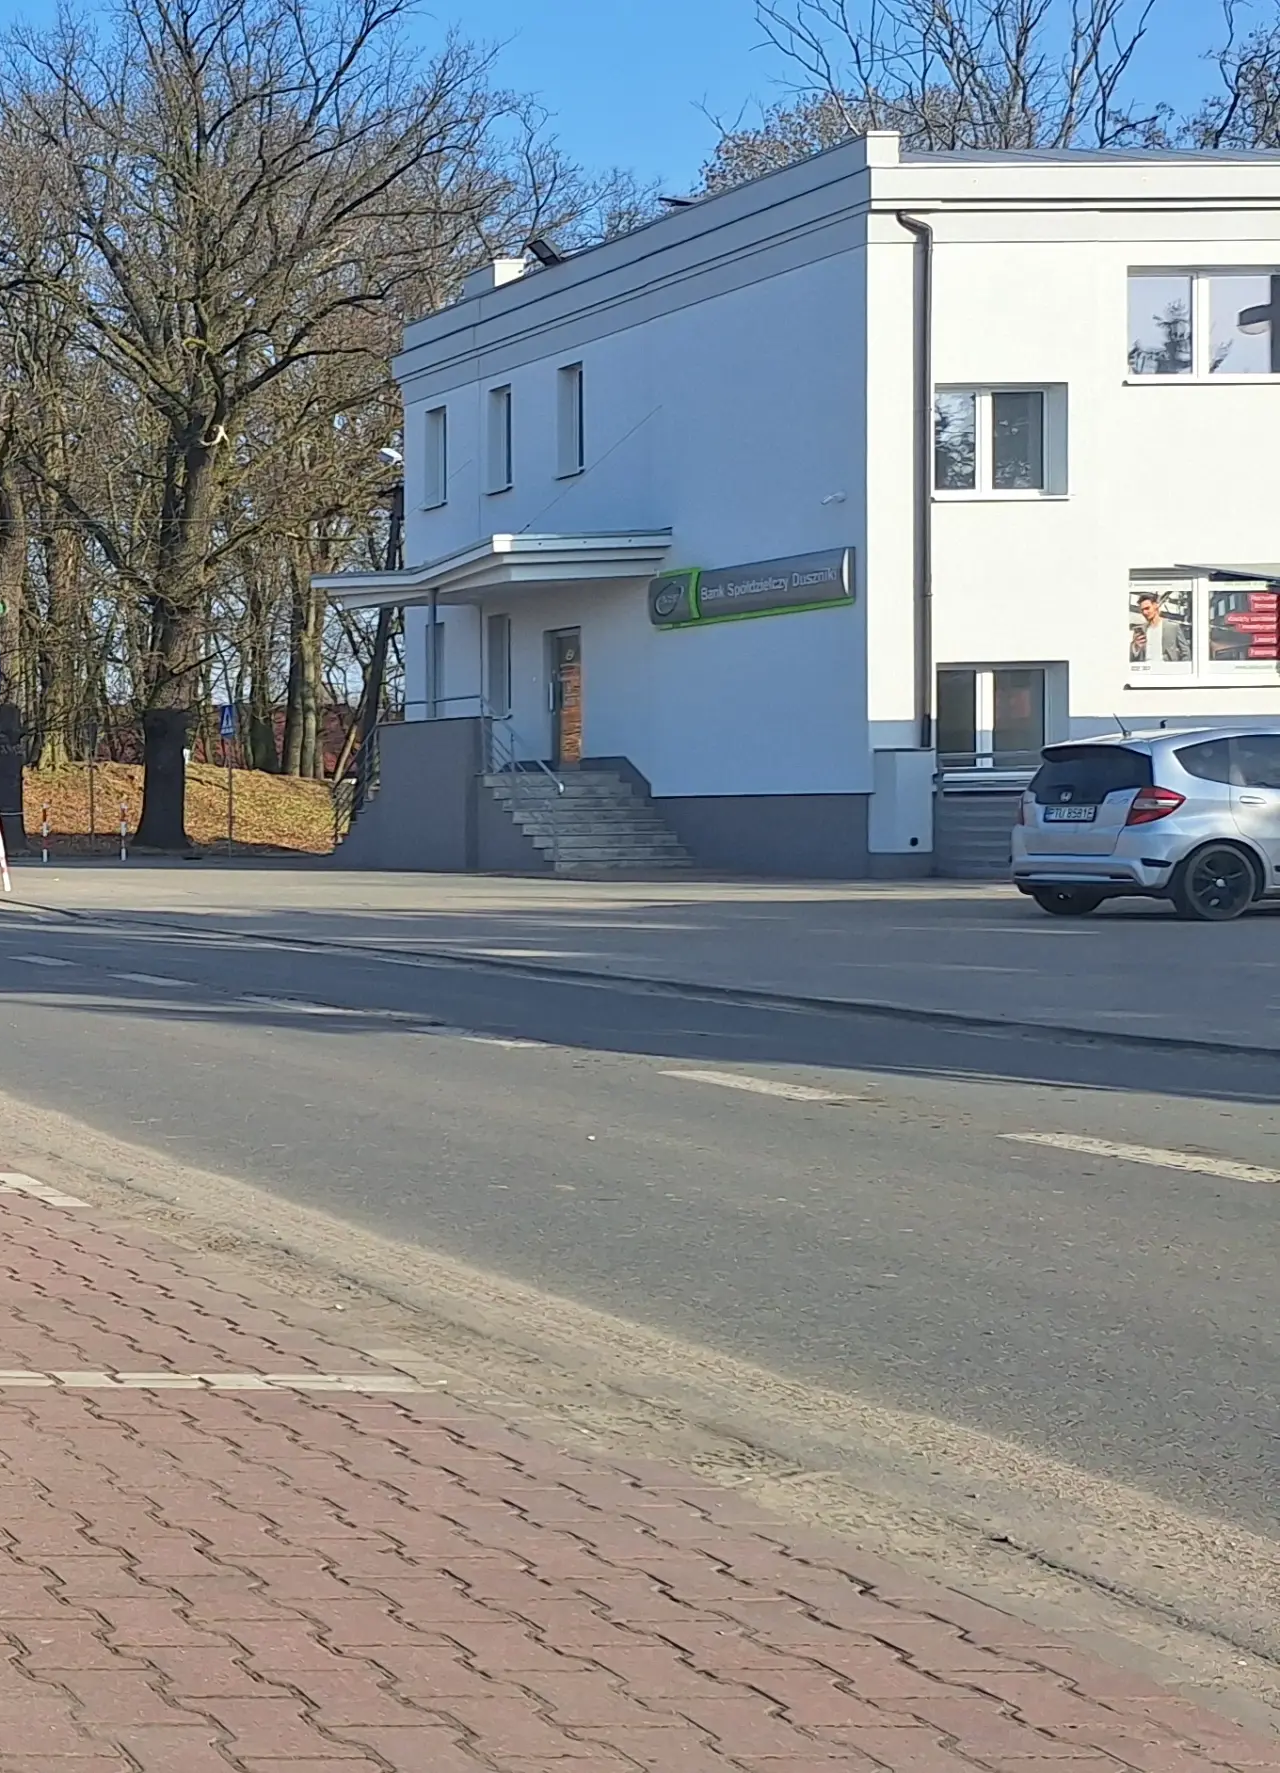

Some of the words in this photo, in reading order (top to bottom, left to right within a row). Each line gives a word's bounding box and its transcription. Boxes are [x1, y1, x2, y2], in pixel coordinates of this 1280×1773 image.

[700, 584, 725, 601] Bank
[727, 576, 789, 598] Spółdzielczy
[791, 567, 837, 587] Duszniki
